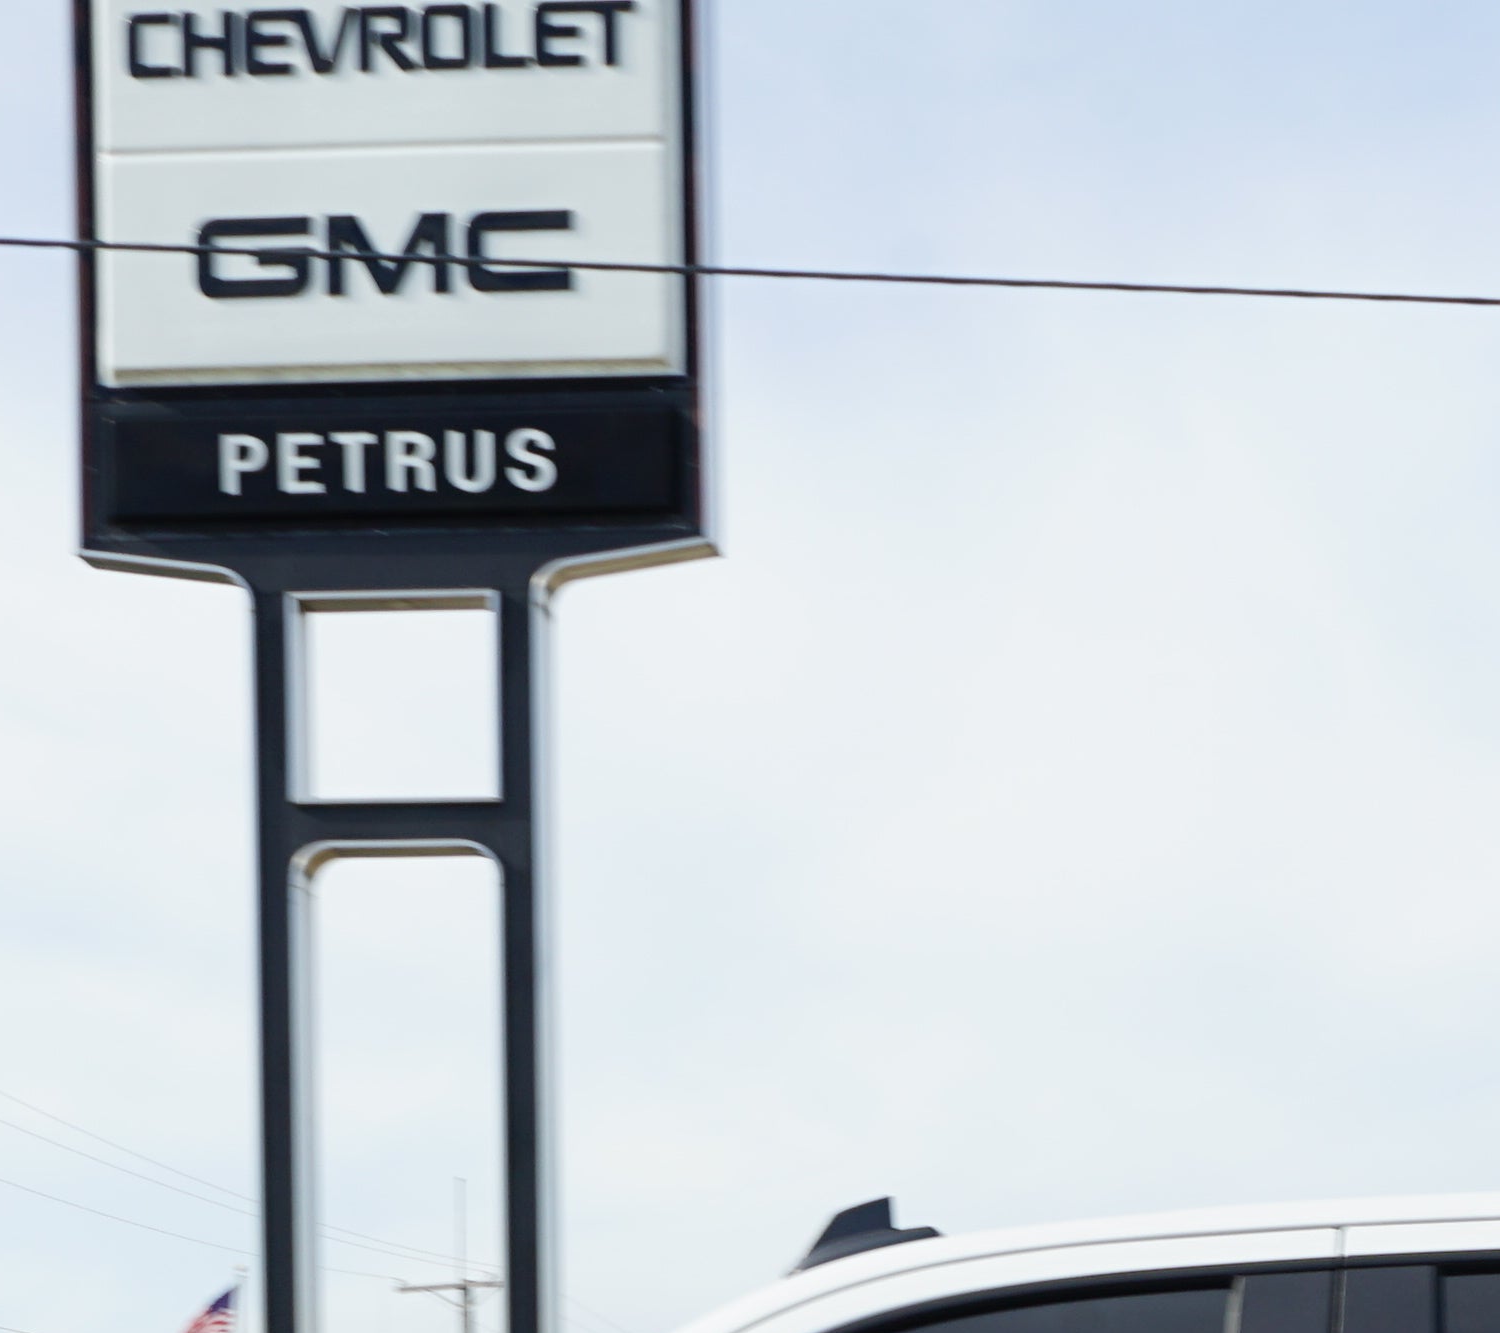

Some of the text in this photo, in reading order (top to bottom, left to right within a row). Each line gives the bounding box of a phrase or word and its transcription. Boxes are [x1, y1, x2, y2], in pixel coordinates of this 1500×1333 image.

[126, 0, 636, 78] CHEVROLET
[197, 209, 574, 299] GMC
[217, 428, 559, 497] PETRUS
